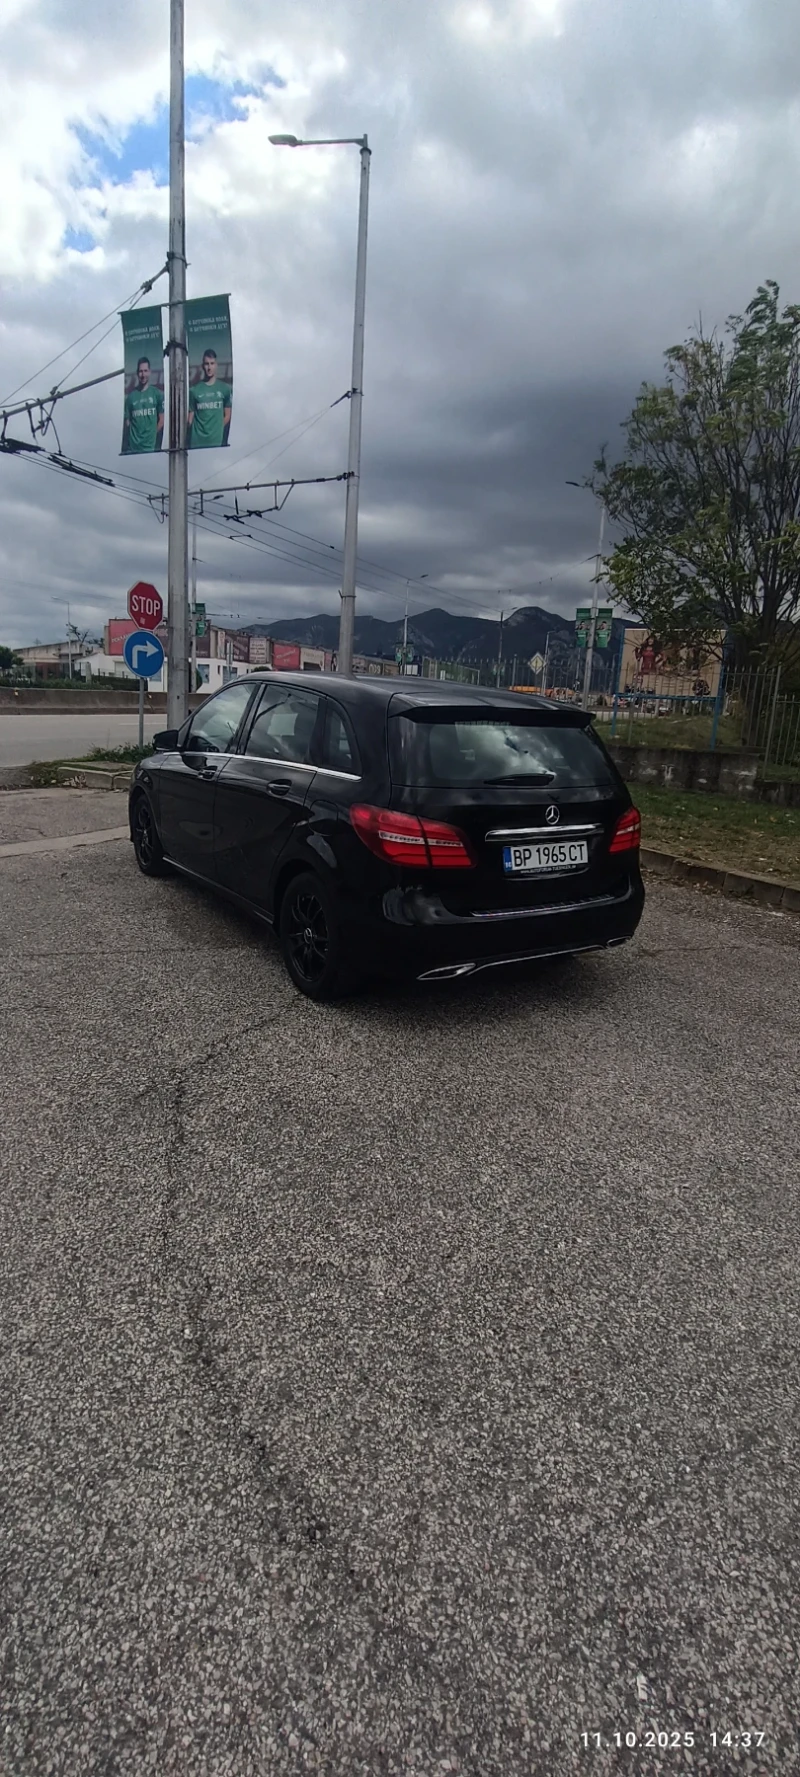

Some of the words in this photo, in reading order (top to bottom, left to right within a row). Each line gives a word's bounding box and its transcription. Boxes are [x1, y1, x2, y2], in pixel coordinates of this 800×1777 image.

[132, 408, 156, 417] WINBET
[196, 401, 222, 410] WINBET
[132, 595, 161, 616] STOP
[513, 849, 532, 867] BP
[536, 846, 567, 865] 1965
[569, 844, 585, 861] CT
